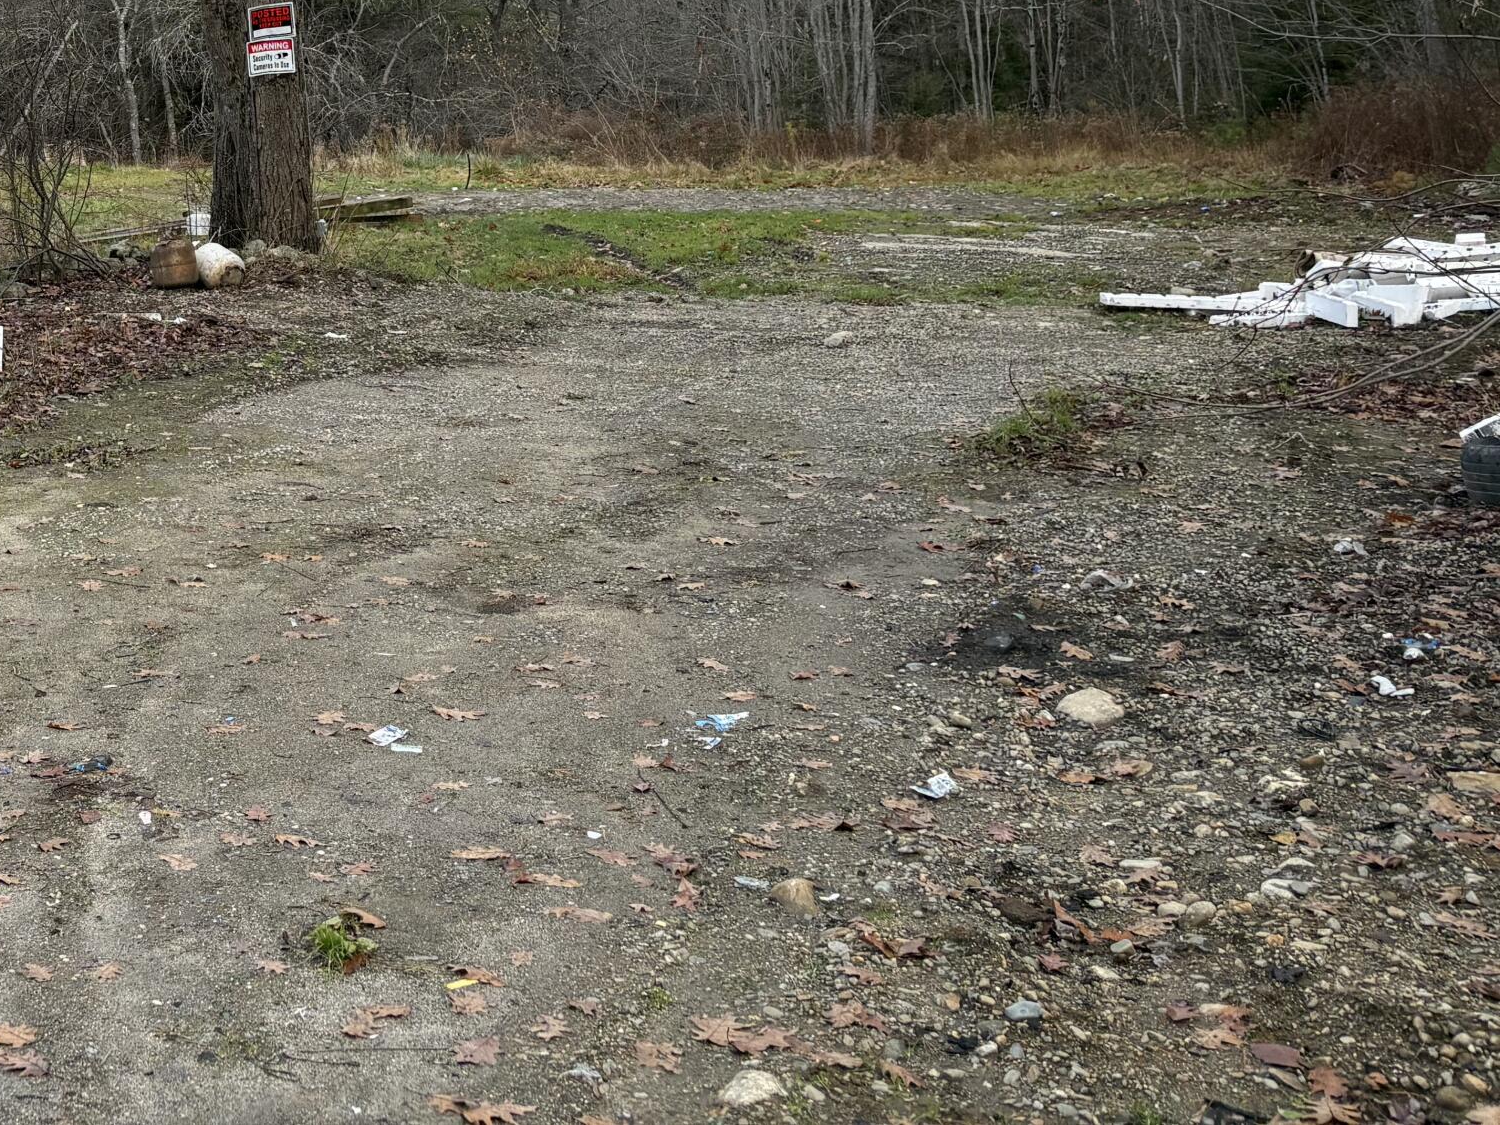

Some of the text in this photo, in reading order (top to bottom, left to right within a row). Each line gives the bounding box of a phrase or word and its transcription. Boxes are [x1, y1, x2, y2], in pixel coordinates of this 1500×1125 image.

[252, 7, 289, 17] POSTED
[251, 41, 289, 52] WARNING
[253, 54, 273, 62] Security
[253, 63, 273, 71] Cameras
